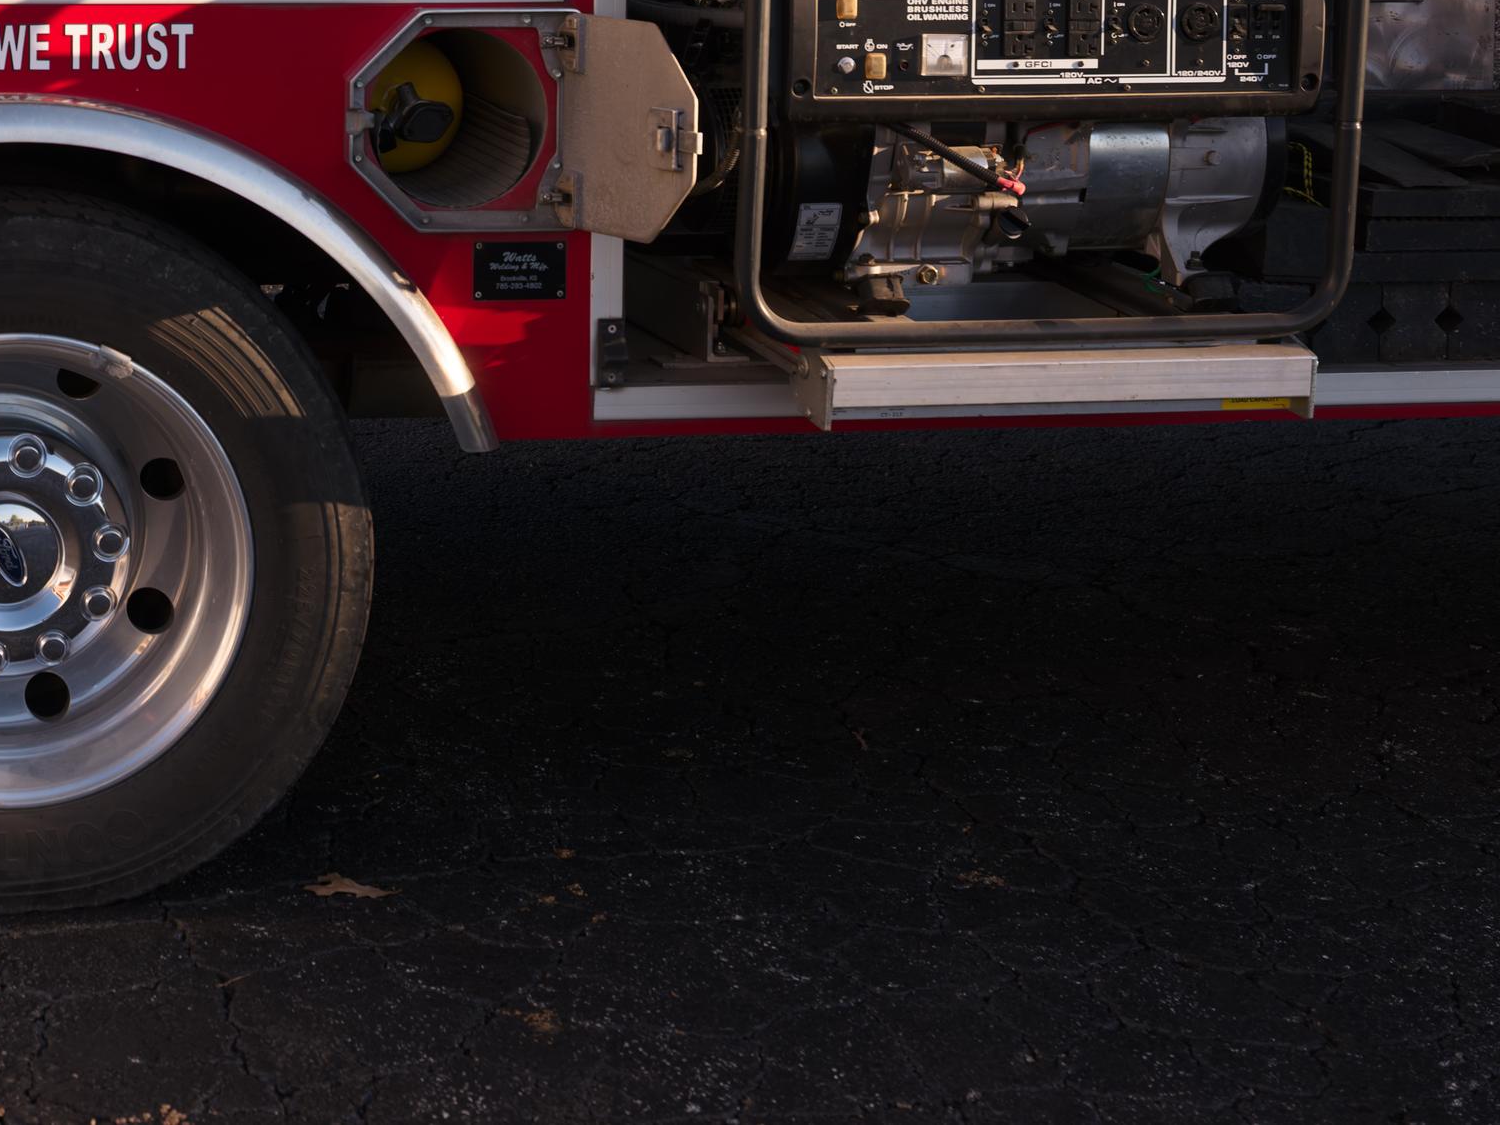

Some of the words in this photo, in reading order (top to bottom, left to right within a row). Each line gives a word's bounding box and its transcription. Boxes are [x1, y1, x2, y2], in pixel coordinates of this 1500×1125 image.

[906, 5, 969, 13] BRUSHLESS
[906, 13, 922, 21] OIL
[922, 13, 969, 21] WARNING
[64, 23, 194, 70] TRUST
[502, 251, 537, 263] Watts
